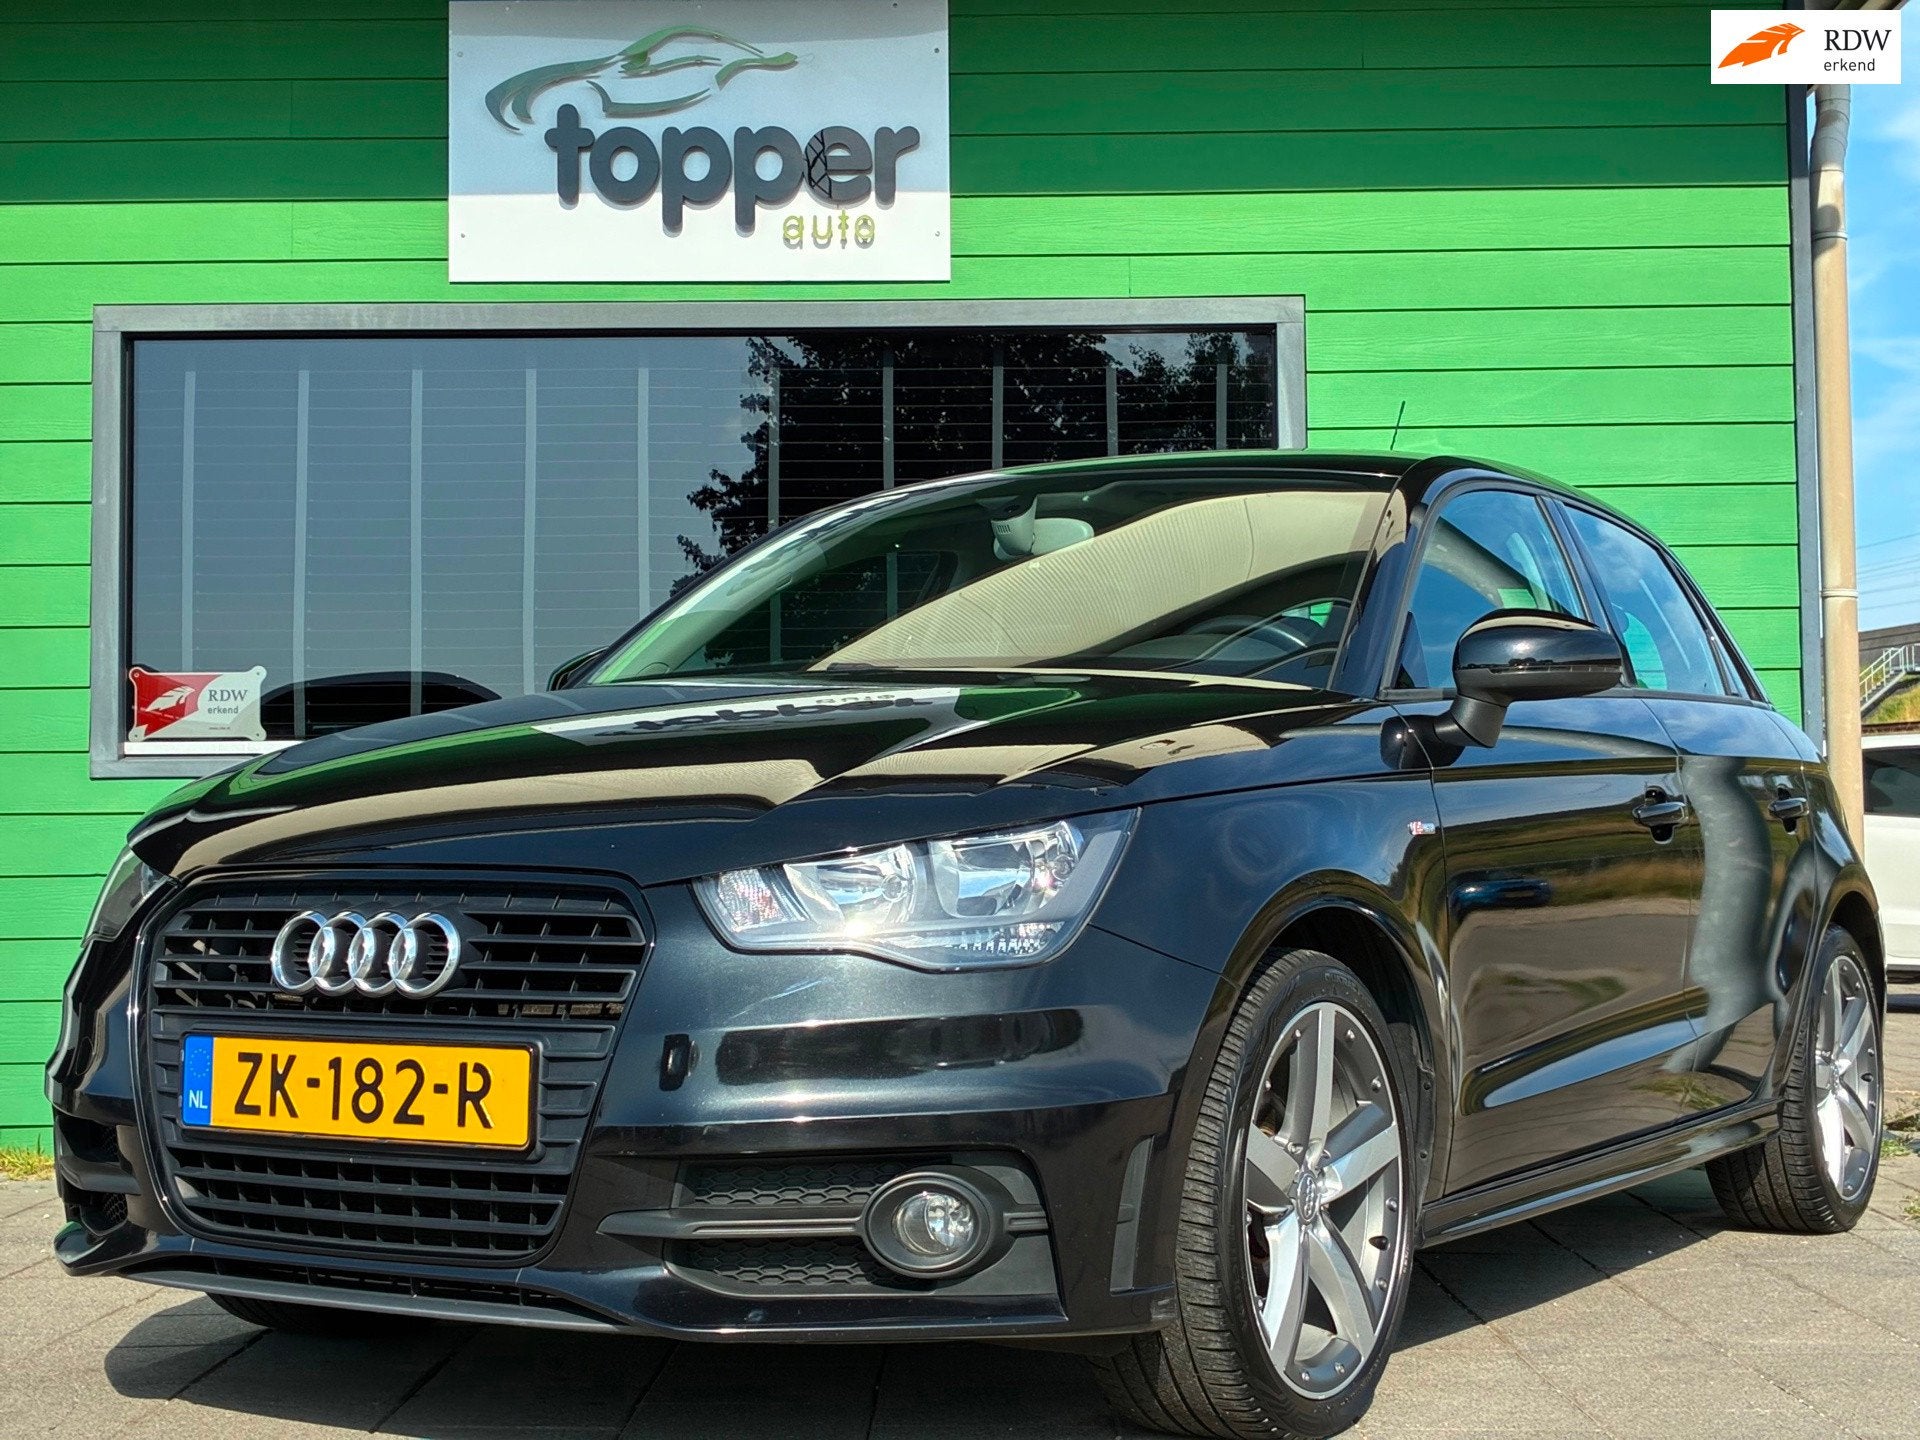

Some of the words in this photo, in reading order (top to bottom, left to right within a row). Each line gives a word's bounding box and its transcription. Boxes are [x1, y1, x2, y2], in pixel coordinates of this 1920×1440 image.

[544, 103, 920, 234] topper
[783, 210, 875, 244] auto
[208, 689, 248, 702] RDW
[207, 705, 239, 714] erkend
[188, 1089, 208, 1110] NL
[234, 1051, 494, 1129] ZK-182-R
